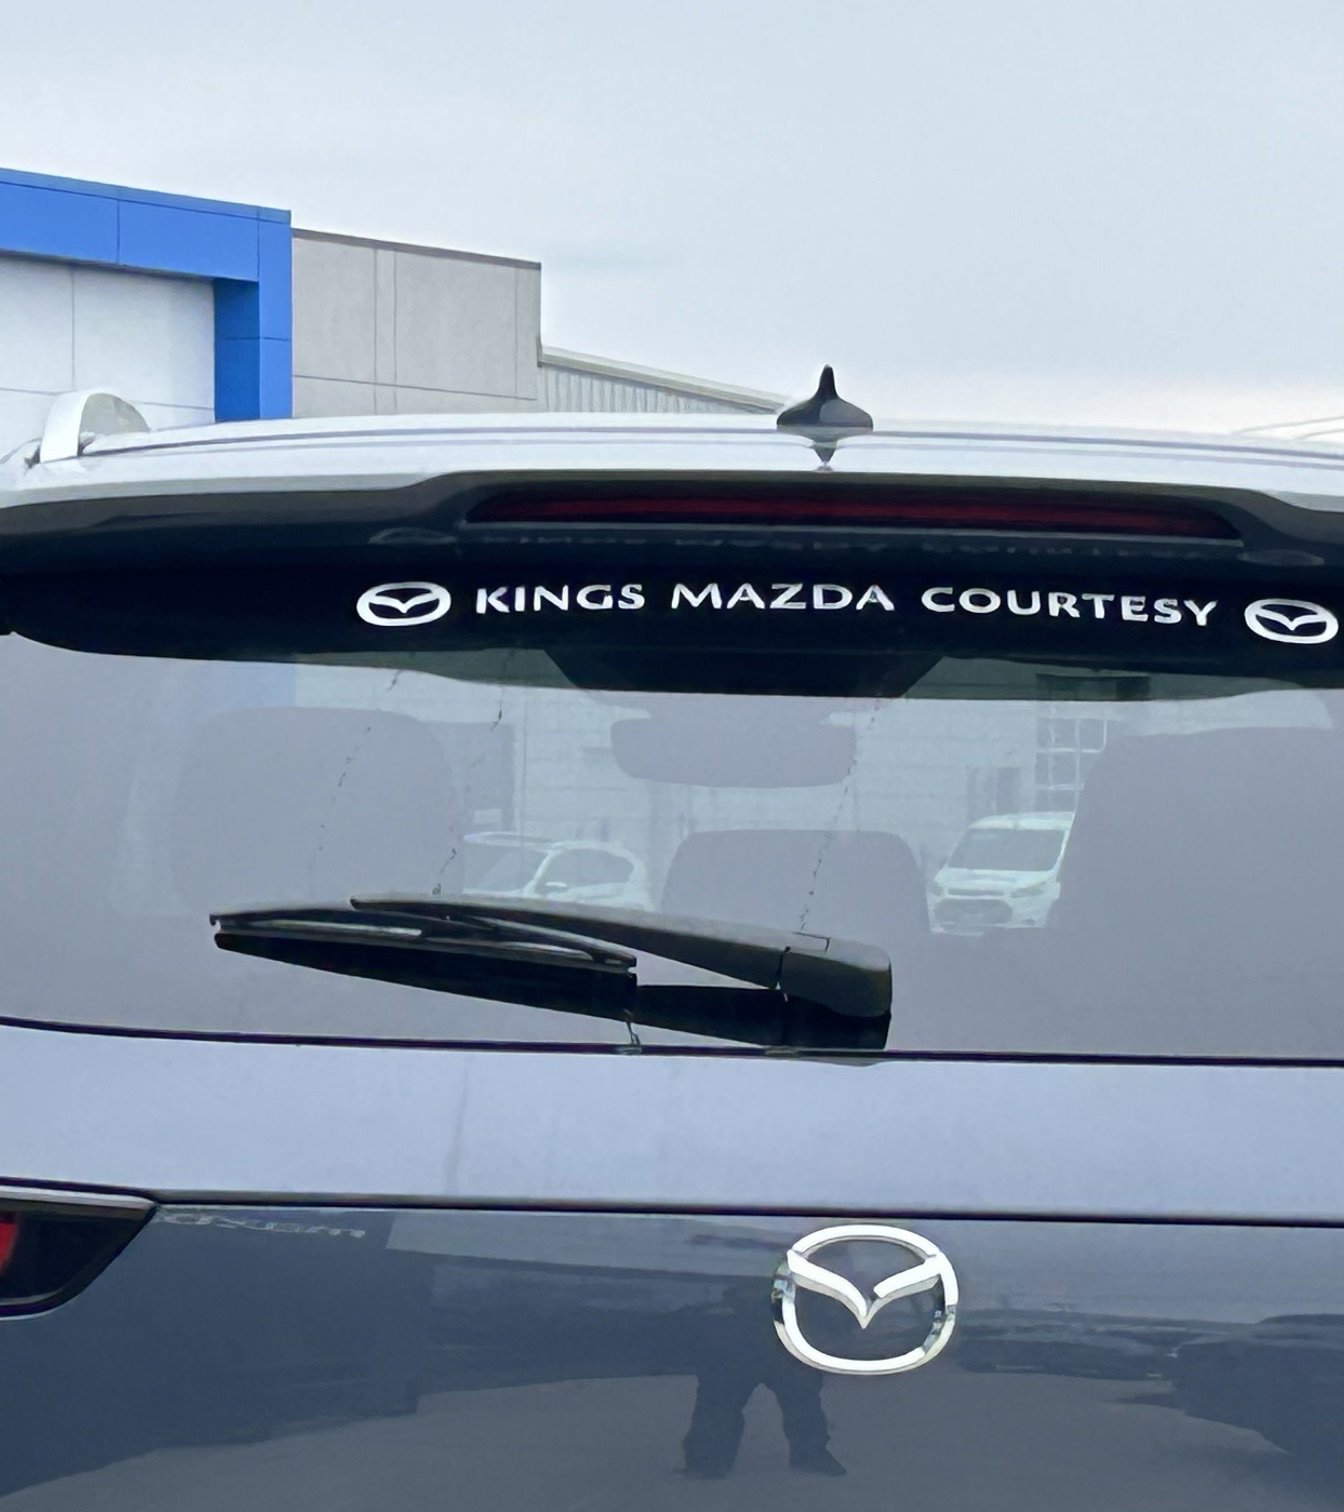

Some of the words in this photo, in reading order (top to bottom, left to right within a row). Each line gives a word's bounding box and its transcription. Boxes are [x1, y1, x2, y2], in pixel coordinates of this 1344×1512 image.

[476, 584, 645, 614] KINGS
[671, 582, 895, 611] MAZDA
[921, 587, 1218, 626] COURTESY
